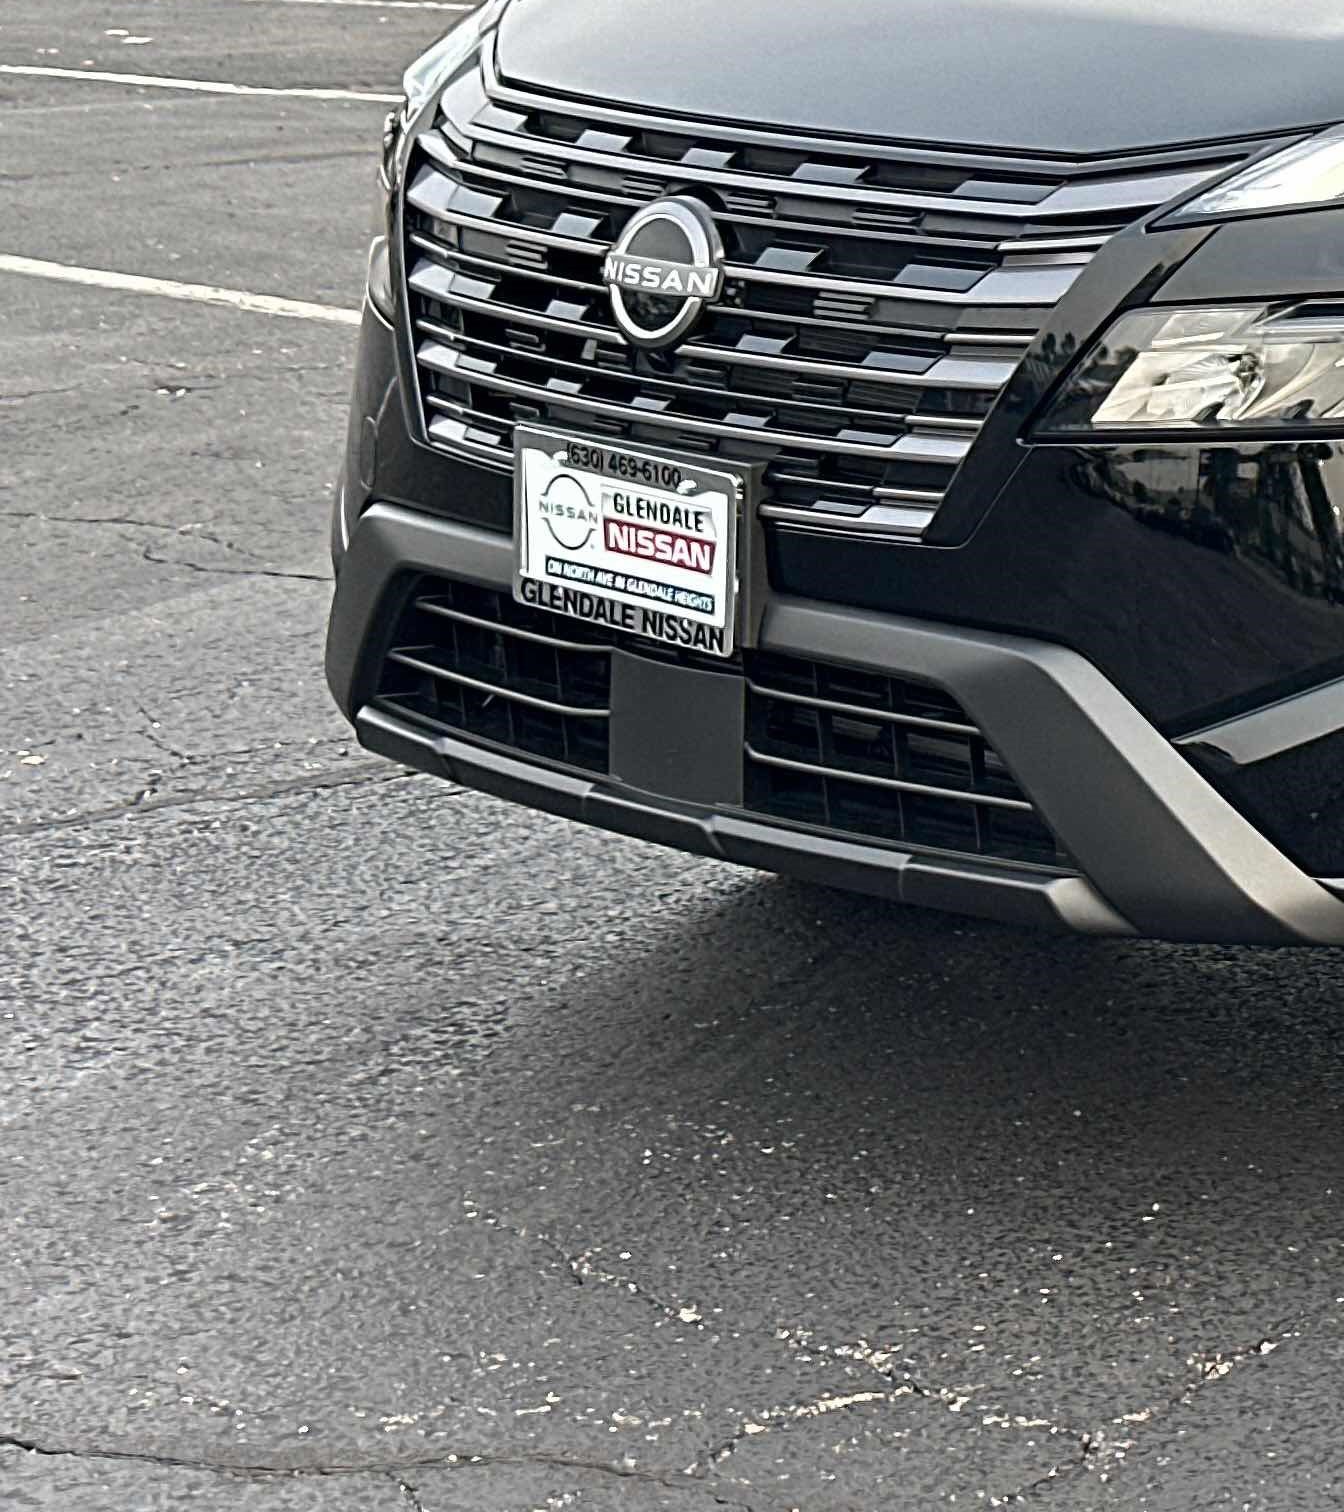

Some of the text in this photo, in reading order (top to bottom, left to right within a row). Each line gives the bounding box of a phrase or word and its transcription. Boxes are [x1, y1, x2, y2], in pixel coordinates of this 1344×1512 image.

[604, 255, 712, 296] NISSAN
[608, 453, 682, 489] 469-6100
[538, 500, 598, 526] NISSAN
[613, 492, 704, 533] GLENDALE
[607, 521, 711, 572] NISSAN
[520, 577, 724, 655] GLENDALE NISSAN
